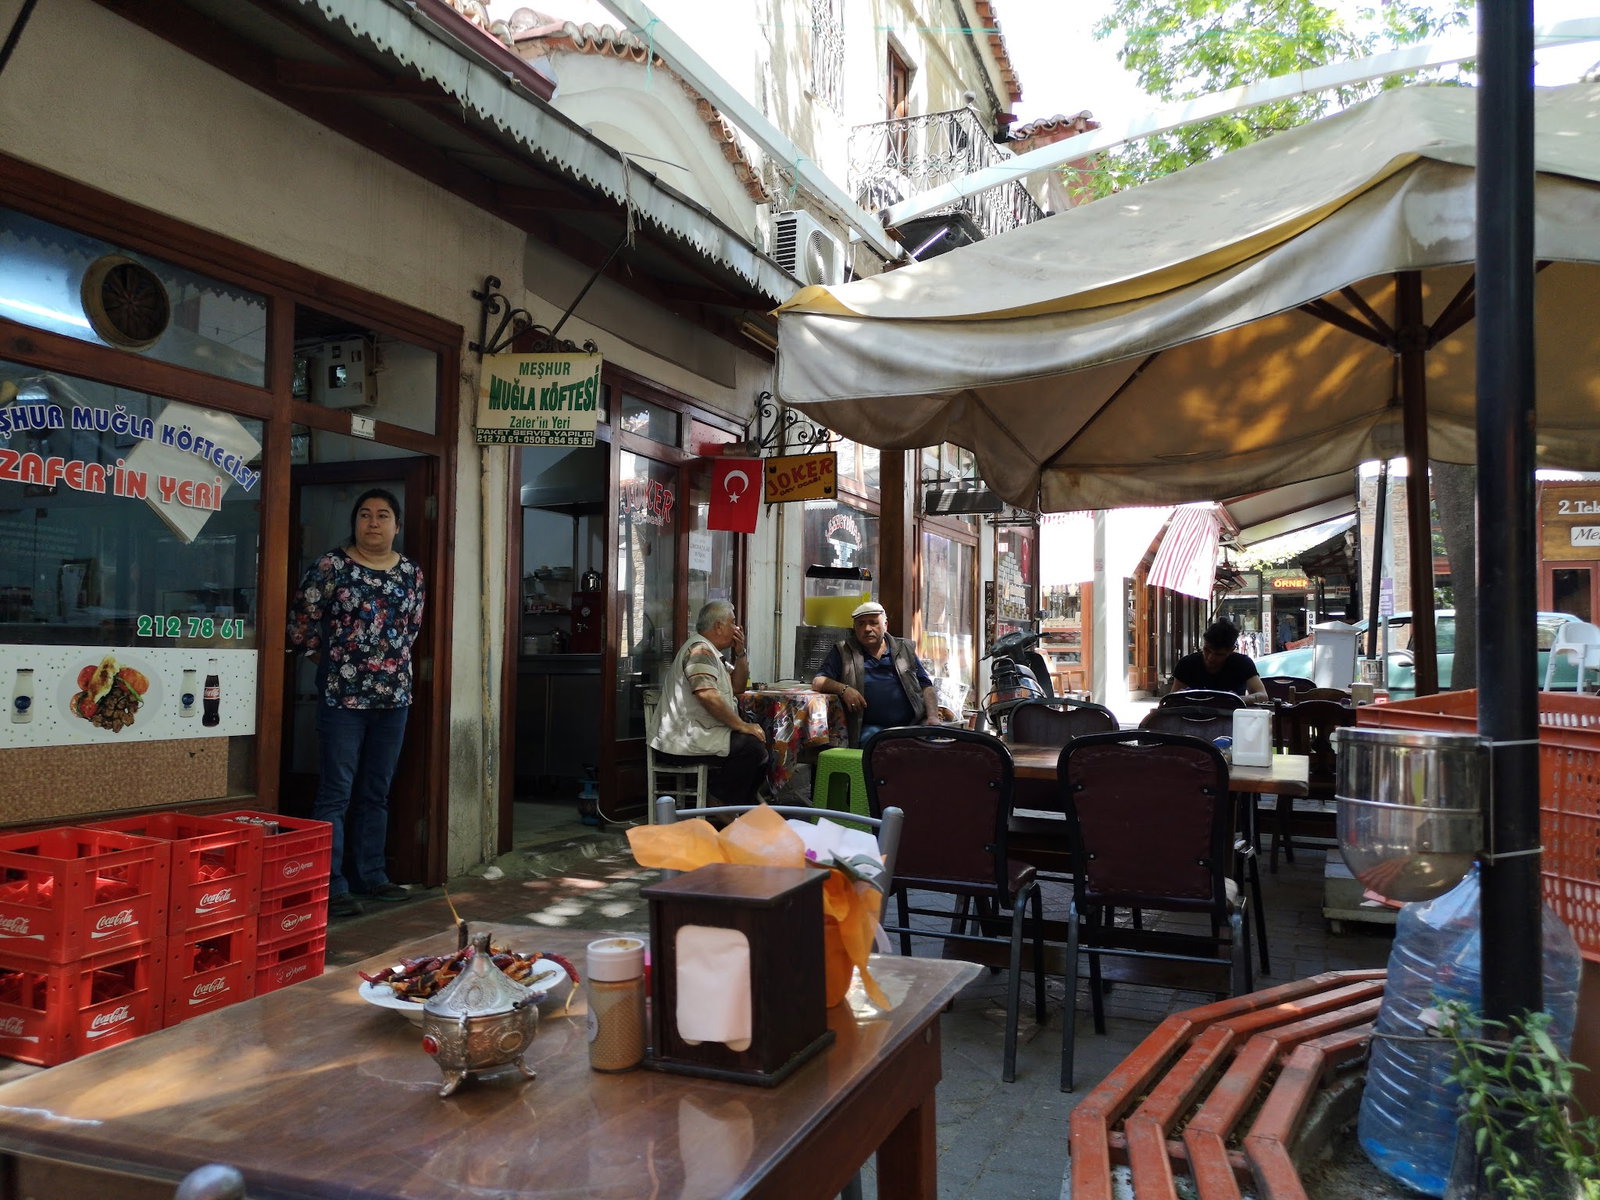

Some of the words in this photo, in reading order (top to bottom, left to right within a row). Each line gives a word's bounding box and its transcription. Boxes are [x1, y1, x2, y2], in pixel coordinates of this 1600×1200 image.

[519, 362, 571, 379] MEŞHUR
[488, 374, 536, 411] MUĞLA
[539, 364, 600, 411] KÖFTESİ
[360, 419, 366, 430] 7
[509, 416, 548, 428] Zafer'in
[552, 416, 571, 429] Yeri
[72, 405, 154, 440] MUĞLA
[161, 424, 260, 492] KÖFTECİSİ
[495, 435, 506, 443] 78
[523, 436, 546, 444] 0506
[567, 437, 580, 445] 55
[581, 437, 593, 445] 95
[0, 447, 148, 500] ZAFER'İN
[158, 476, 222, 511] YERİ
[767, 457, 834, 496] JOKER
[623, 479, 674, 523] JOKER
[1558, 500, 1570, 514] 2
[137, 615, 182, 638] 212
[187, 616, 215, 640] 78
[220, 617, 244, 640] 61
